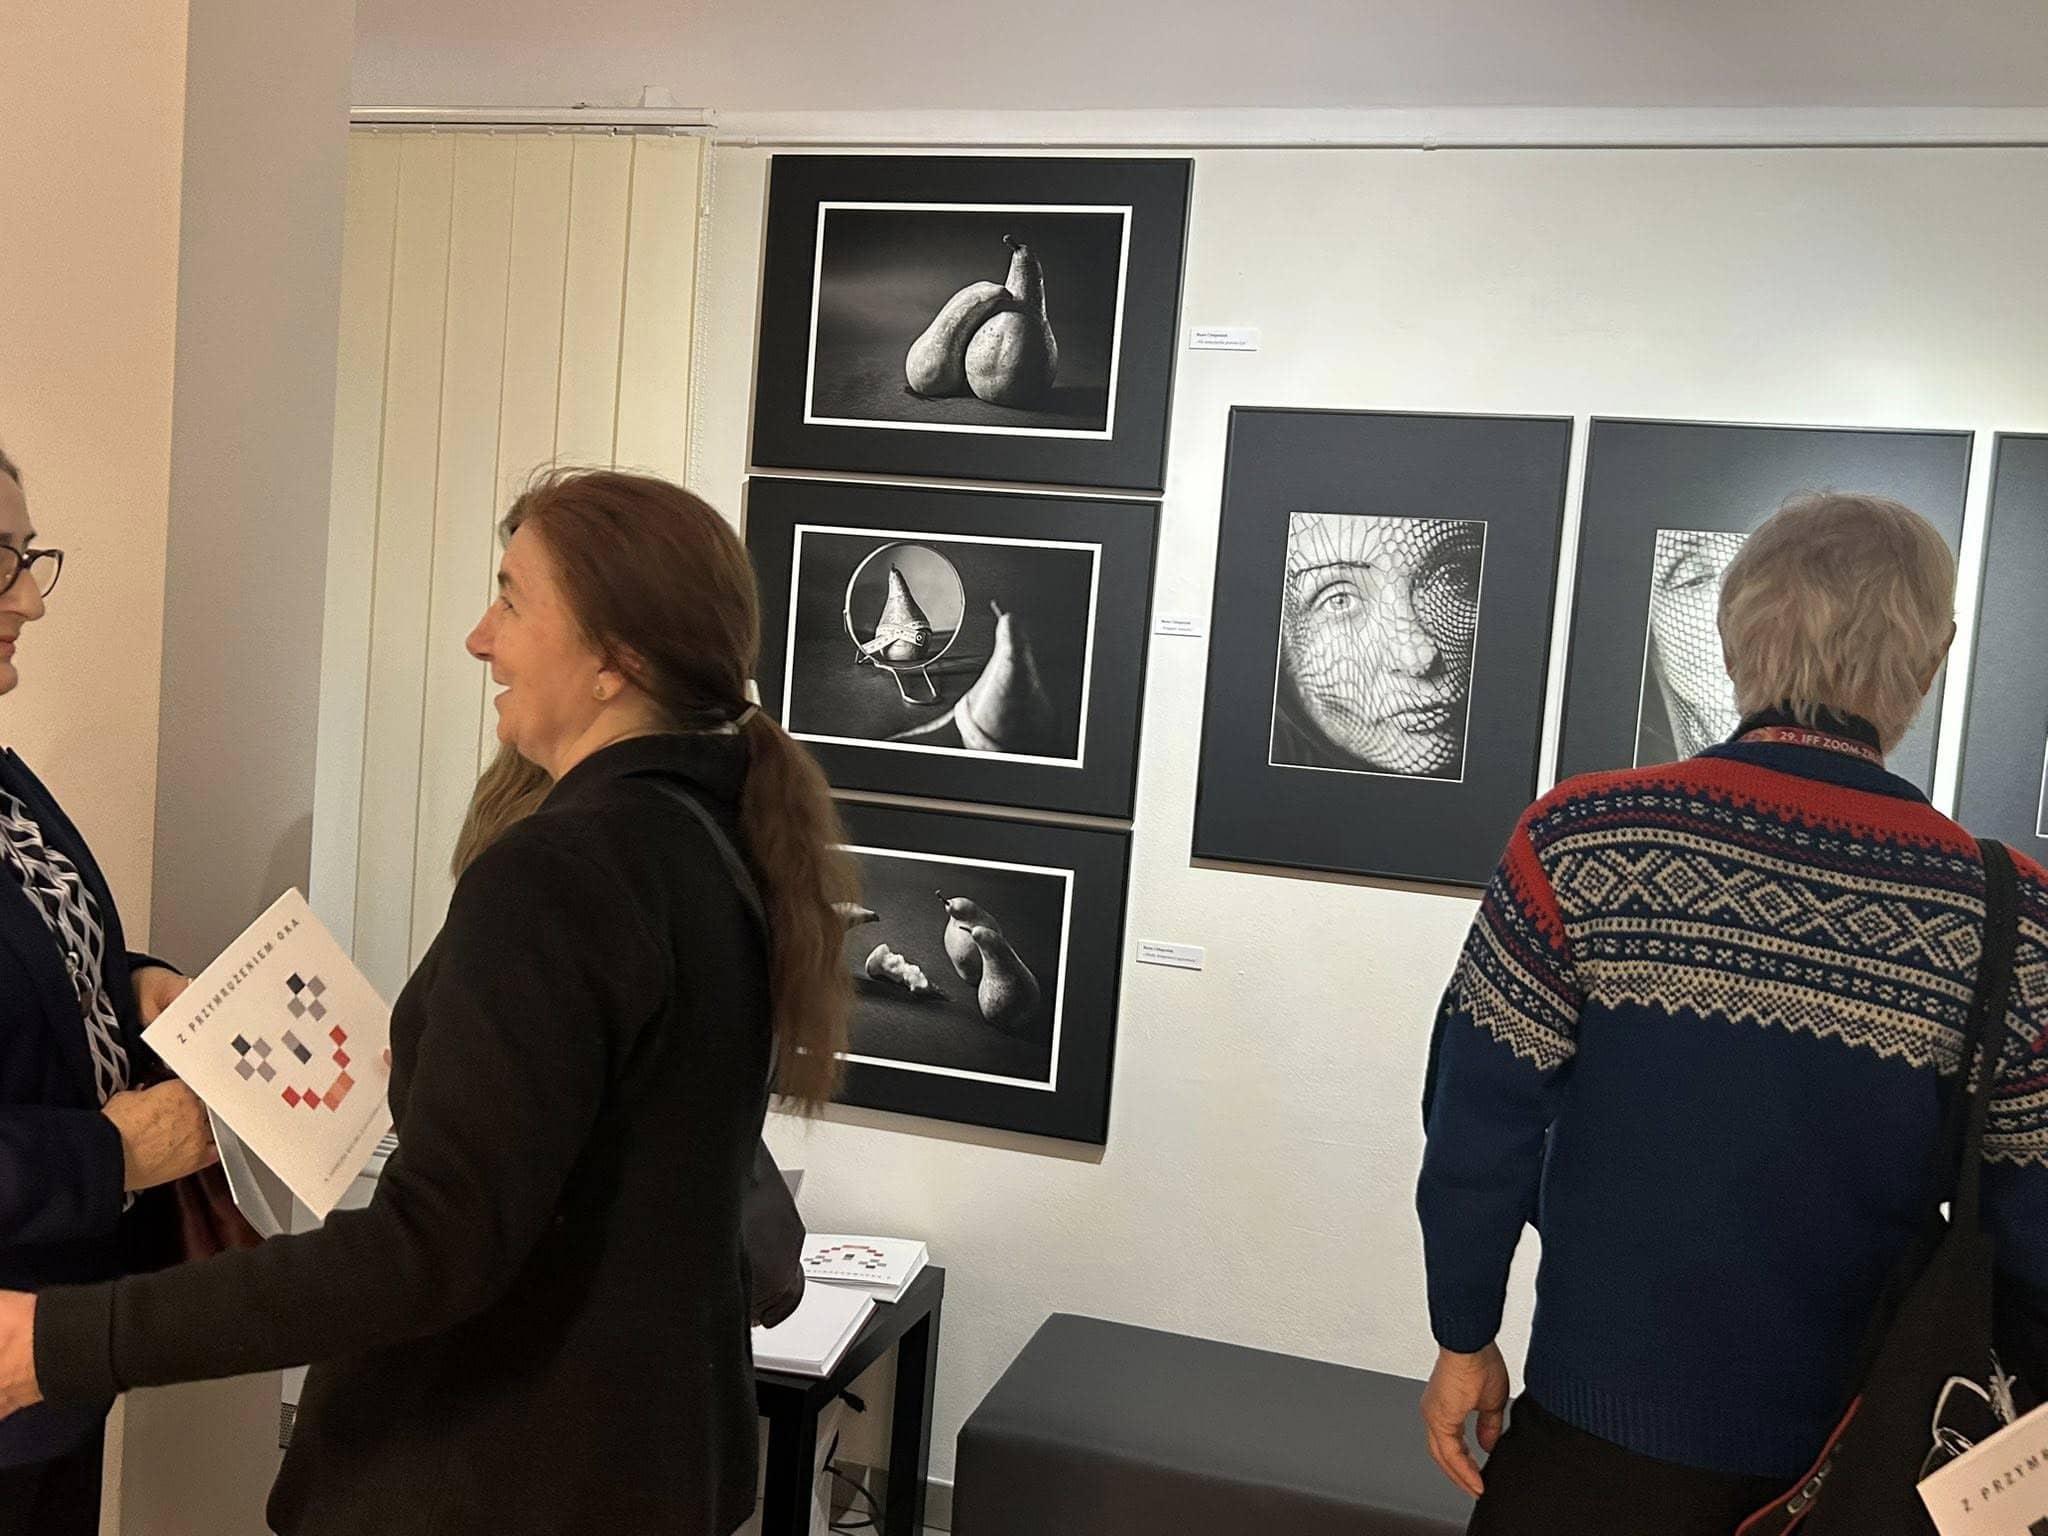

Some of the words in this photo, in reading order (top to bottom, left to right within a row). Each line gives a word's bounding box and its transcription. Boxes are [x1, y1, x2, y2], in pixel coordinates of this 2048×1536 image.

[1780, 731, 1800, 743] 29.
[1801, 734, 1821, 746] IFF
[177, 1033, 188, 1045] Z
[276, 918, 300, 941] OKA
